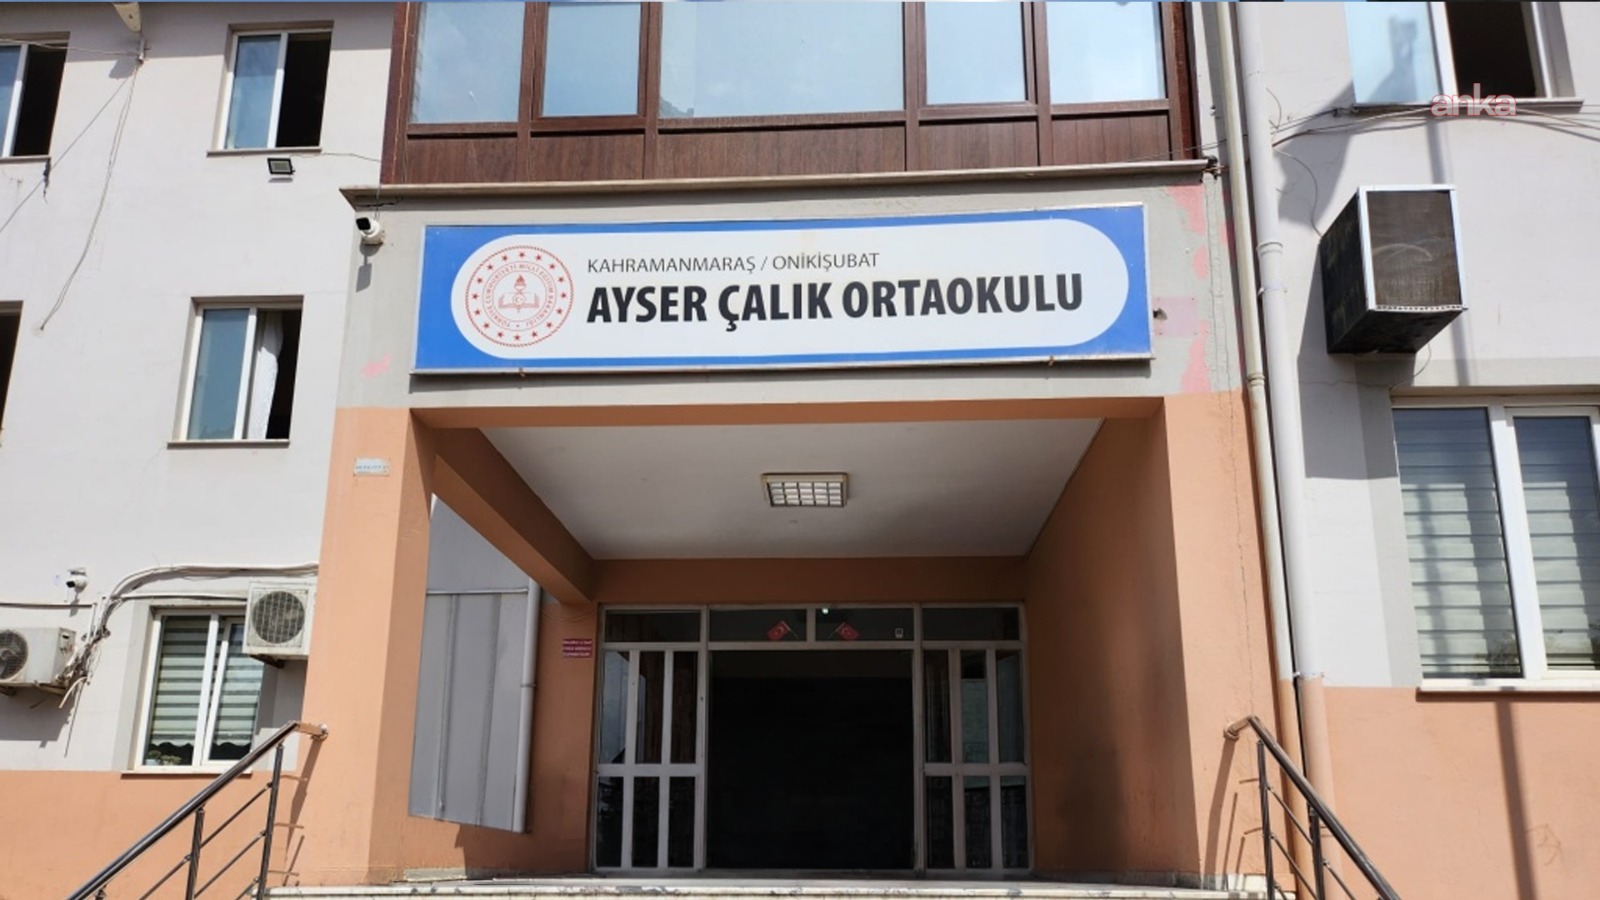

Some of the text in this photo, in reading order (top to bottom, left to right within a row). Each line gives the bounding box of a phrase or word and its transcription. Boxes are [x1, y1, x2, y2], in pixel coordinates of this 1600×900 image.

[587, 256, 757, 275] KAHRAMANMARAŞ
[772, 251, 880, 273] ONİKİŞUBAT
[586, 273, 1083, 333] AYSER ÇALIK ORTAOKULU
